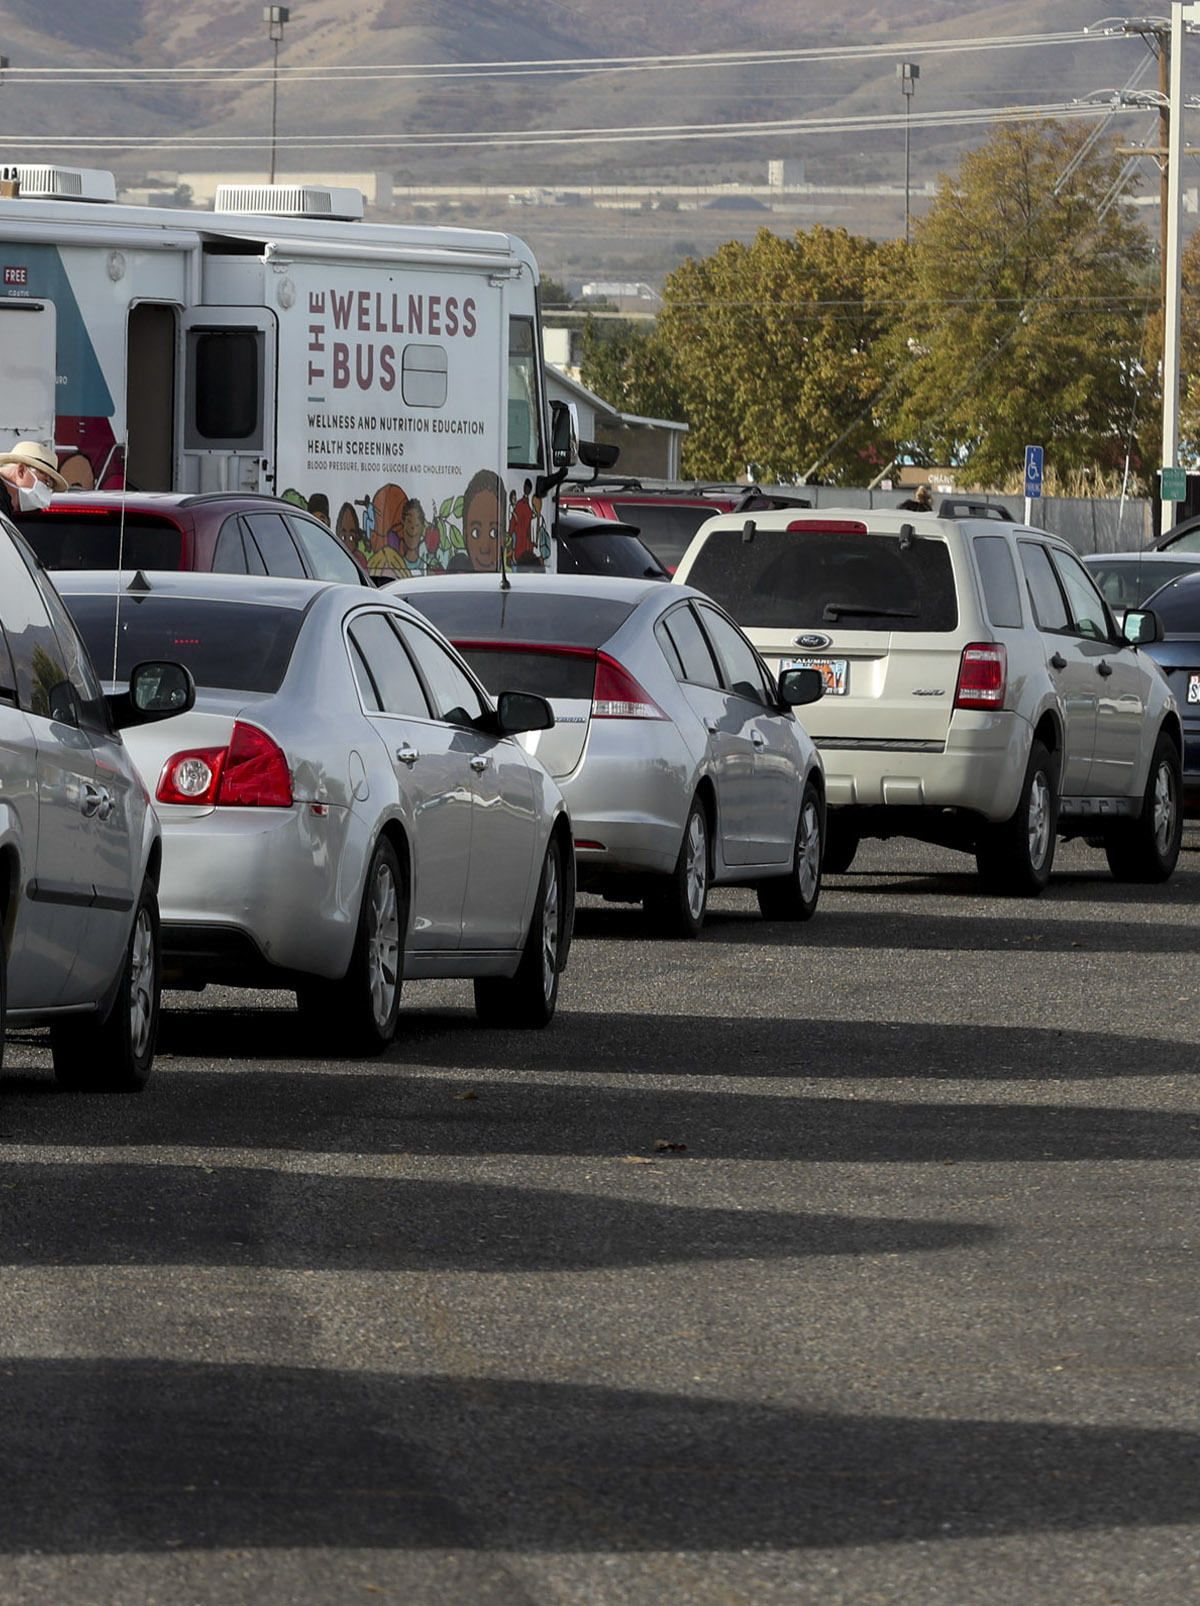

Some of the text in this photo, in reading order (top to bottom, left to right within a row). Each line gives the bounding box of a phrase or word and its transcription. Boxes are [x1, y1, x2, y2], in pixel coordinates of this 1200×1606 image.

[5, 269, 26, 282] FREE
[330, 289, 477, 338] WELLNESS
[308, 291, 325, 386] THE
[333, 342, 396, 391] BUS
[307, 414, 485, 435] WELLNESS AND NUTRITION EDUCATION
[307, 440, 404, 457] HEALTH SCREENINGS
[307, 460, 462, 475] BLOOD PRESSURE, BLOOD GLUCOSE AND CHOLESTEROL
